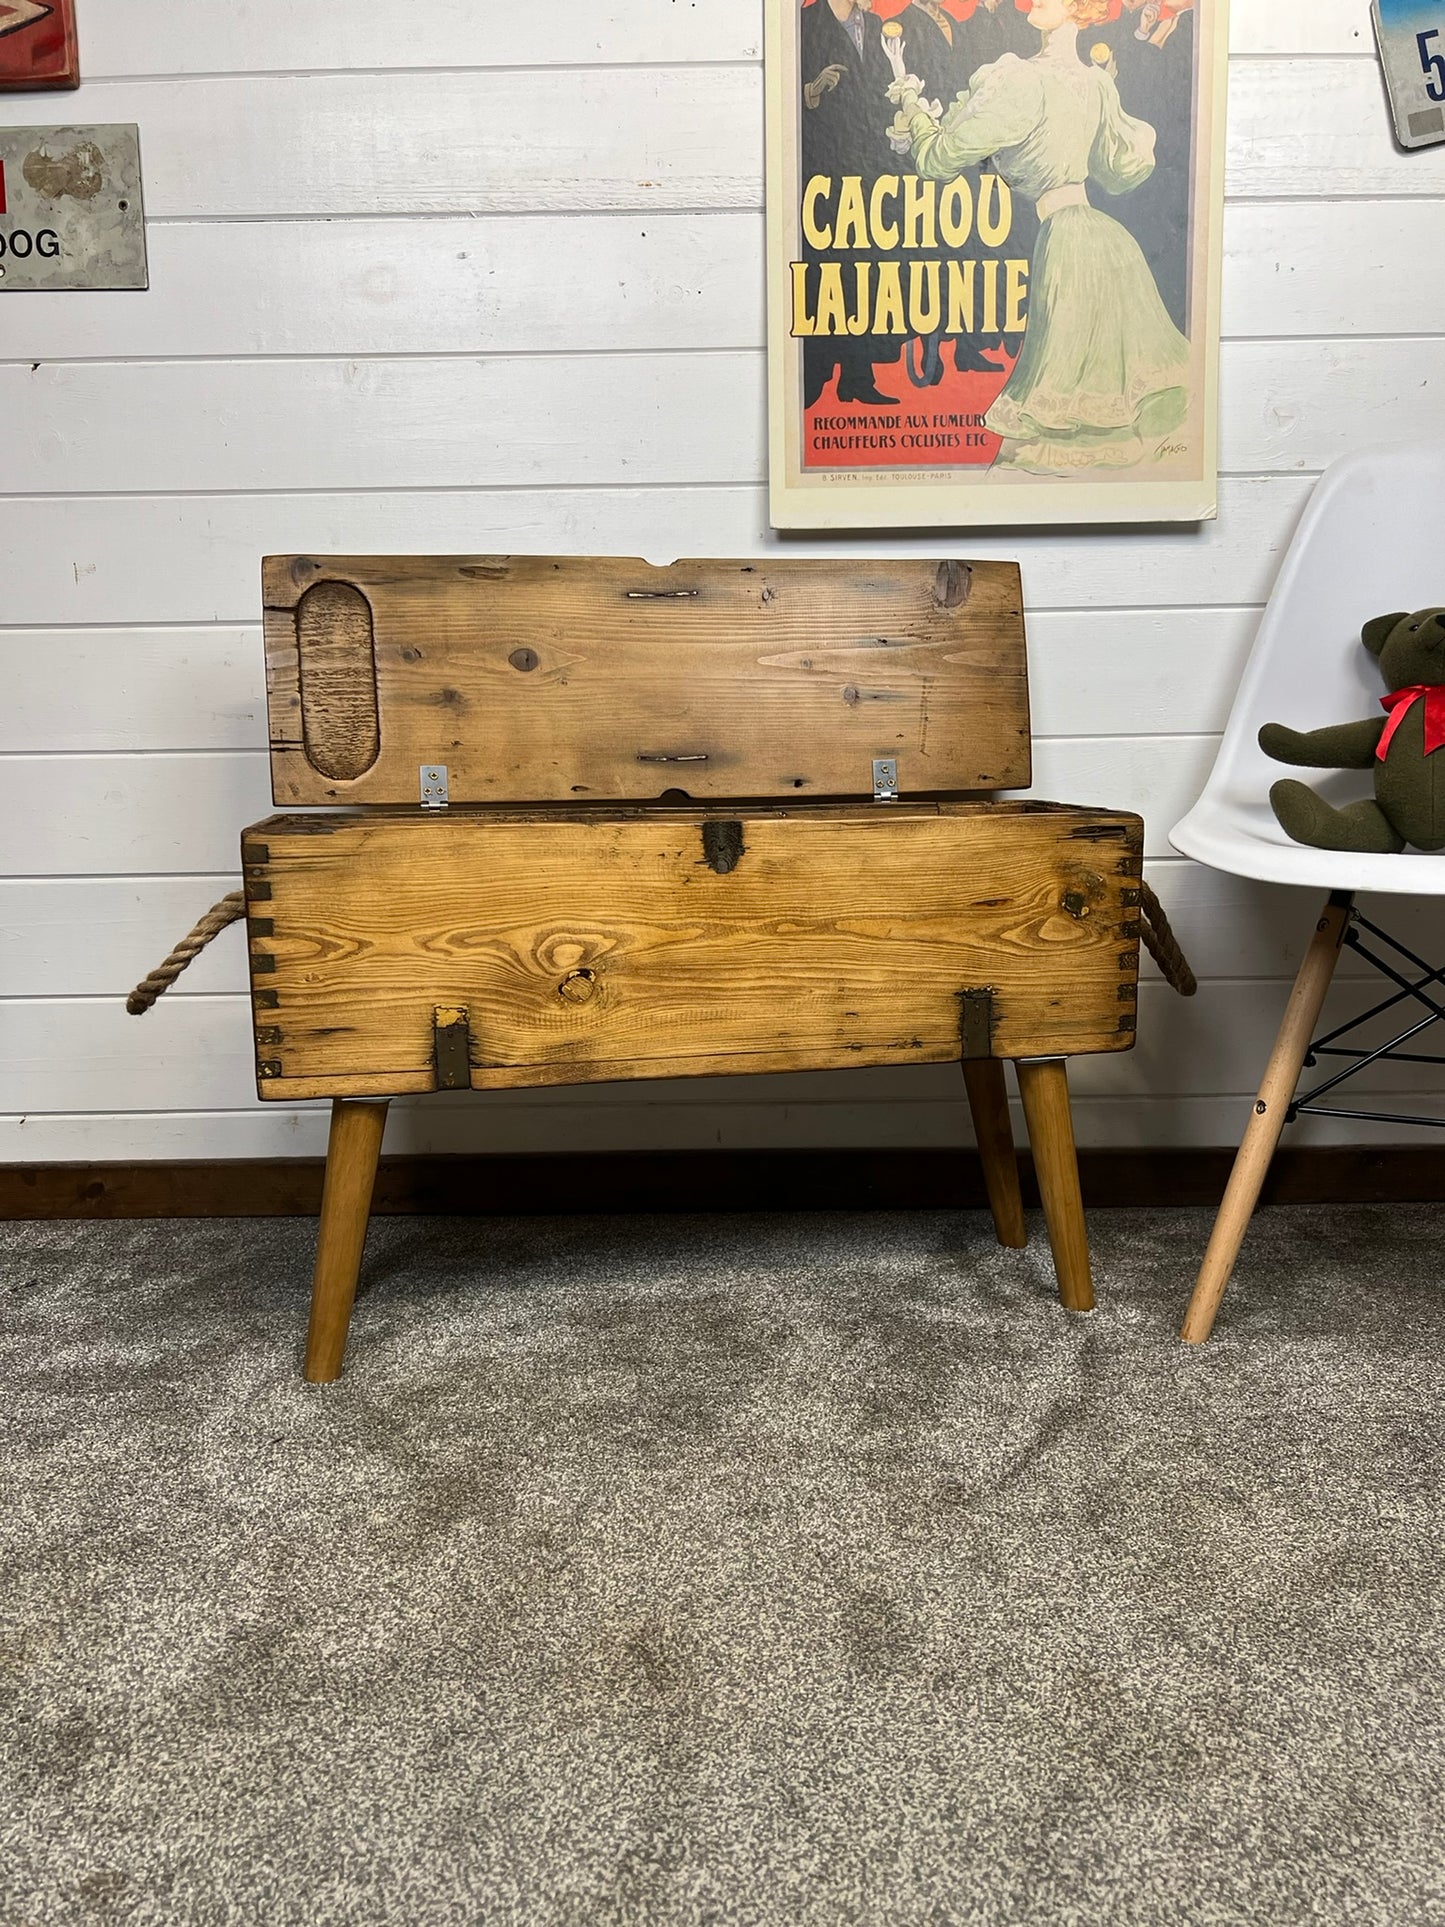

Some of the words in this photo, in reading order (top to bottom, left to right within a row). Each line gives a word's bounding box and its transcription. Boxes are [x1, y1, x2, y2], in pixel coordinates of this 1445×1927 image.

[801, 174, 1013, 251] CACHOU
[789, 259, 1030, 337] LAJAUNIE
[813, 415, 901, 431] RECOMMANDE
[906, 415, 929, 429] AUX
[813, 435, 896, 450] CHAUFFEURS
[901, 434, 960, 448] CYCLISTES
[966, 433, 988, 447] ETC
